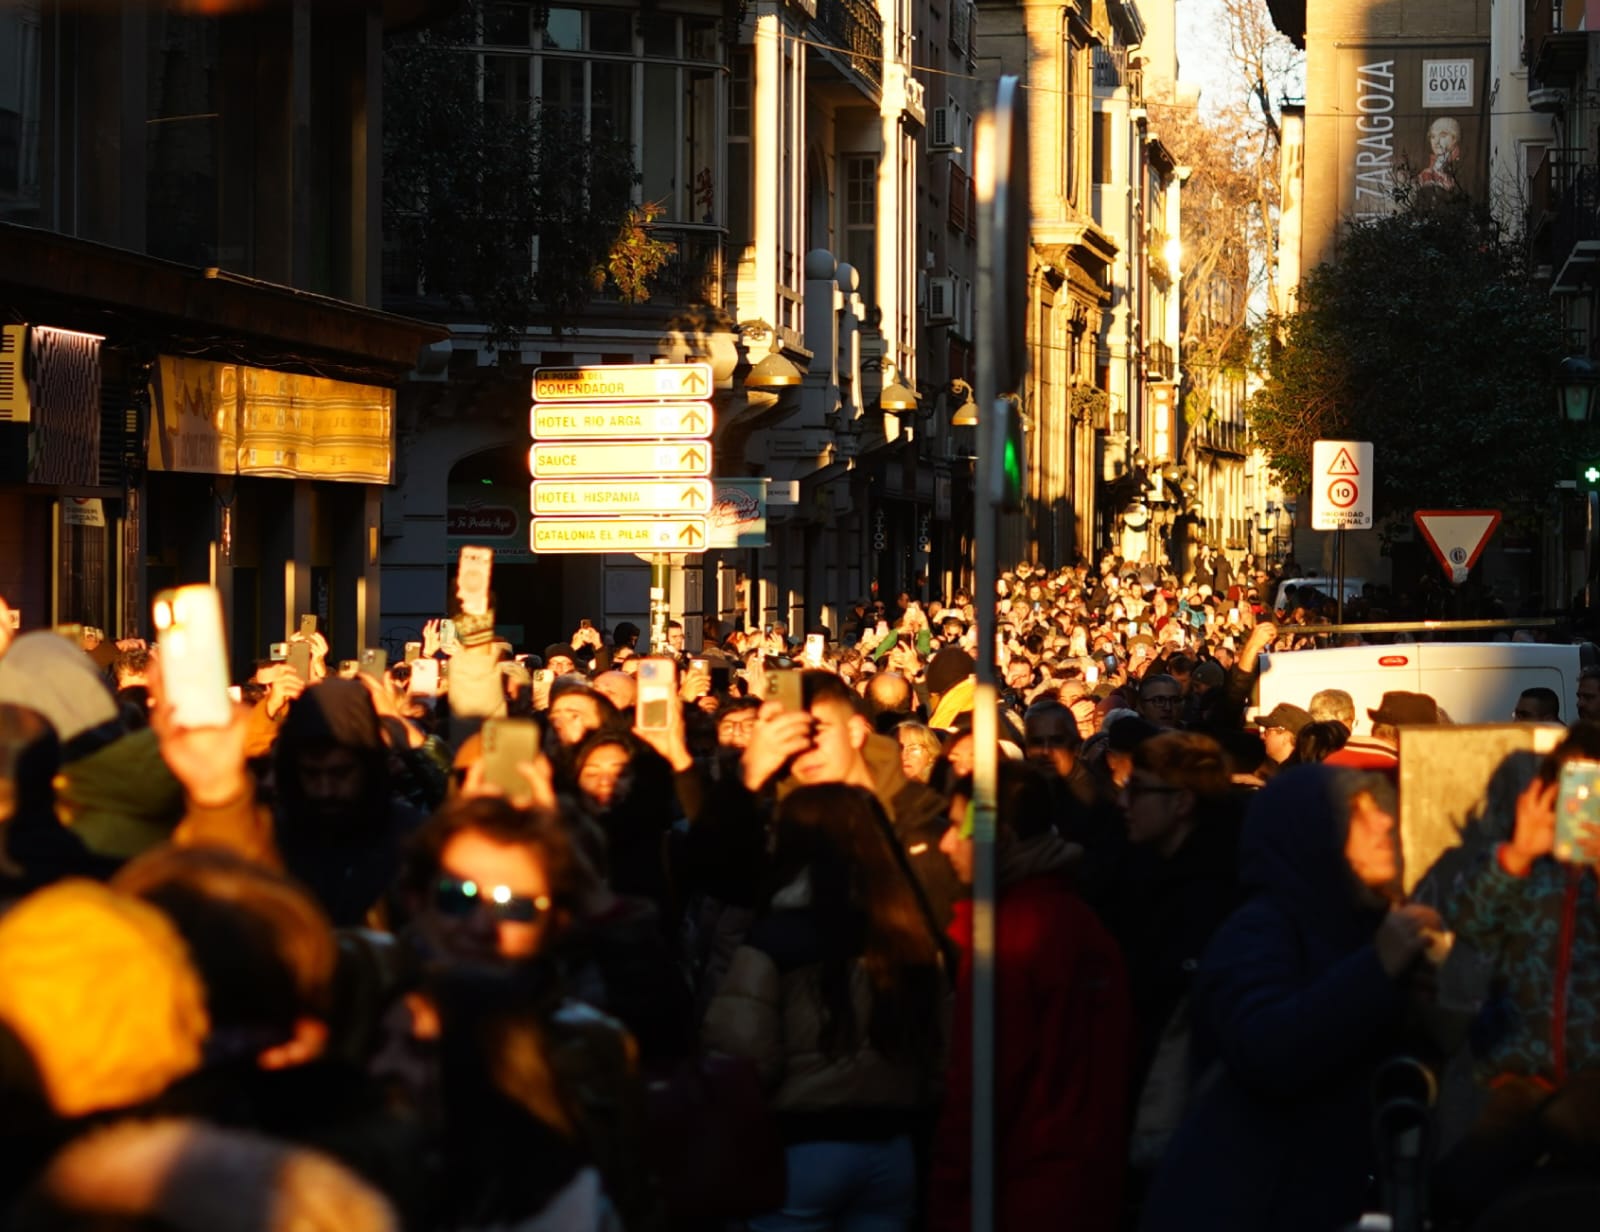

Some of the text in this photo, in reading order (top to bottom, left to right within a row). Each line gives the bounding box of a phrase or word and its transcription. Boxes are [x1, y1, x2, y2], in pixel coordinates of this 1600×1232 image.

[1429, 64, 1468, 78] MUSEO
[1429, 78, 1466, 91] GOYA
[1356, 60, 1394, 200] ZARAGOZA
[539, 383, 624, 394] COMENDADOR
[538, 415, 641, 428] HOTEL RIO ARGA
[538, 454, 577, 466] SAUCE
[538, 491, 640, 503] HOTEL HISPANIA
[1336, 488, 1350, 498] 10
[537, 529, 649, 541] CATALONIA EL PILAR
